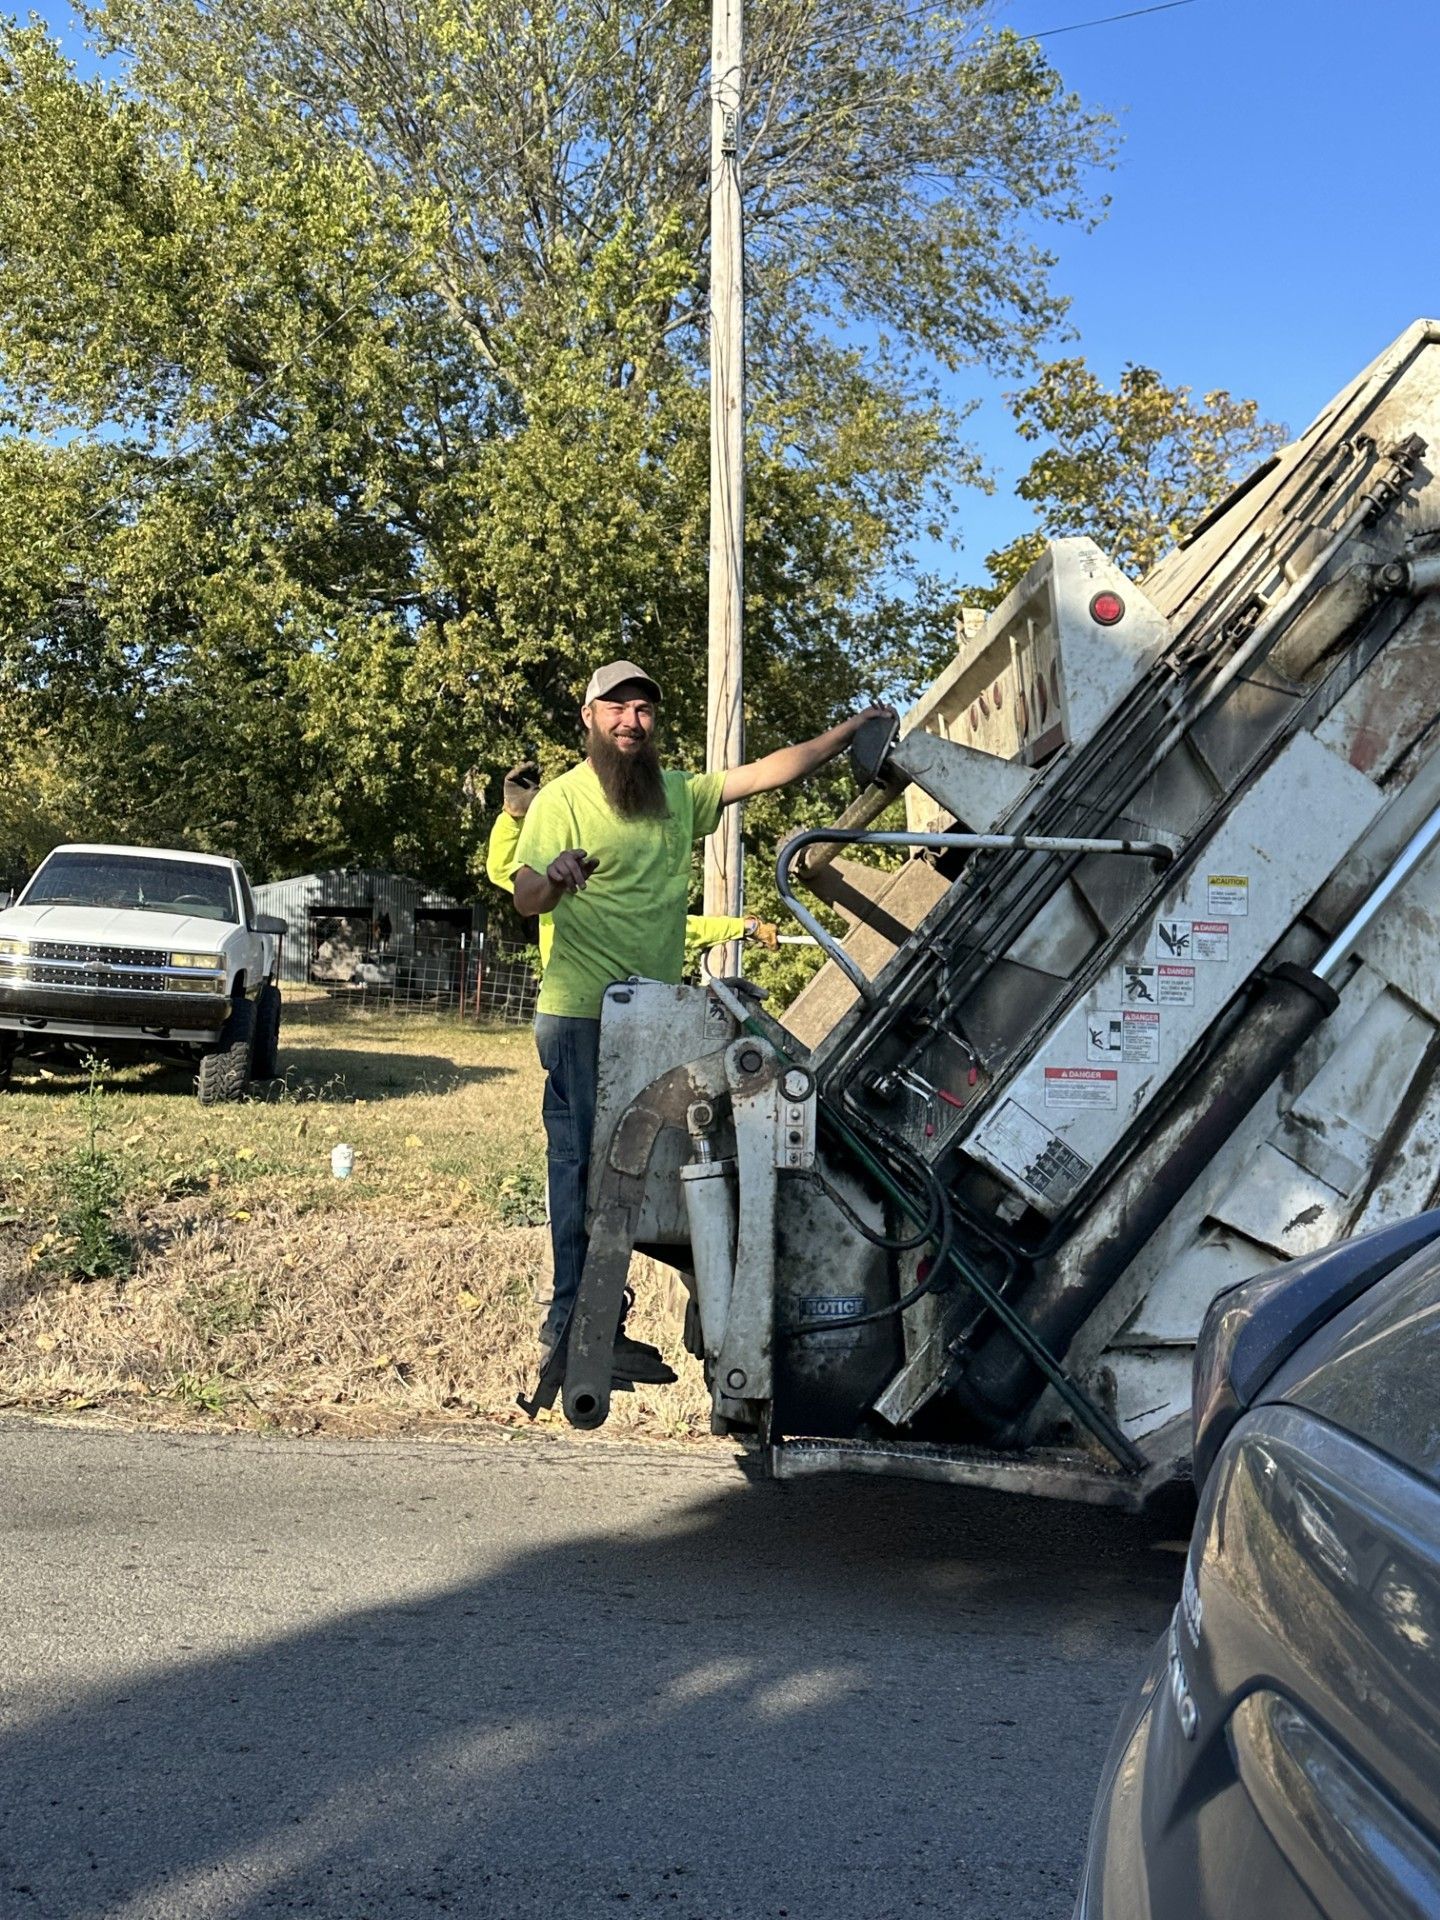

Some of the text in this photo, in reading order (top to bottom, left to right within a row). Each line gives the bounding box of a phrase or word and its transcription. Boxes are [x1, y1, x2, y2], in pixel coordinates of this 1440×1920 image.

[1216, 877, 1246, 886] CAUTION
[1200, 924, 1228, 932] DANGER
[1167, 967, 1194, 976] DANGER
[1131, 1013, 1159, 1021] DANGER
[1068, 1071, 1102, 1079] DANGER
[805, 1301, 864, 1314] NOTICE
